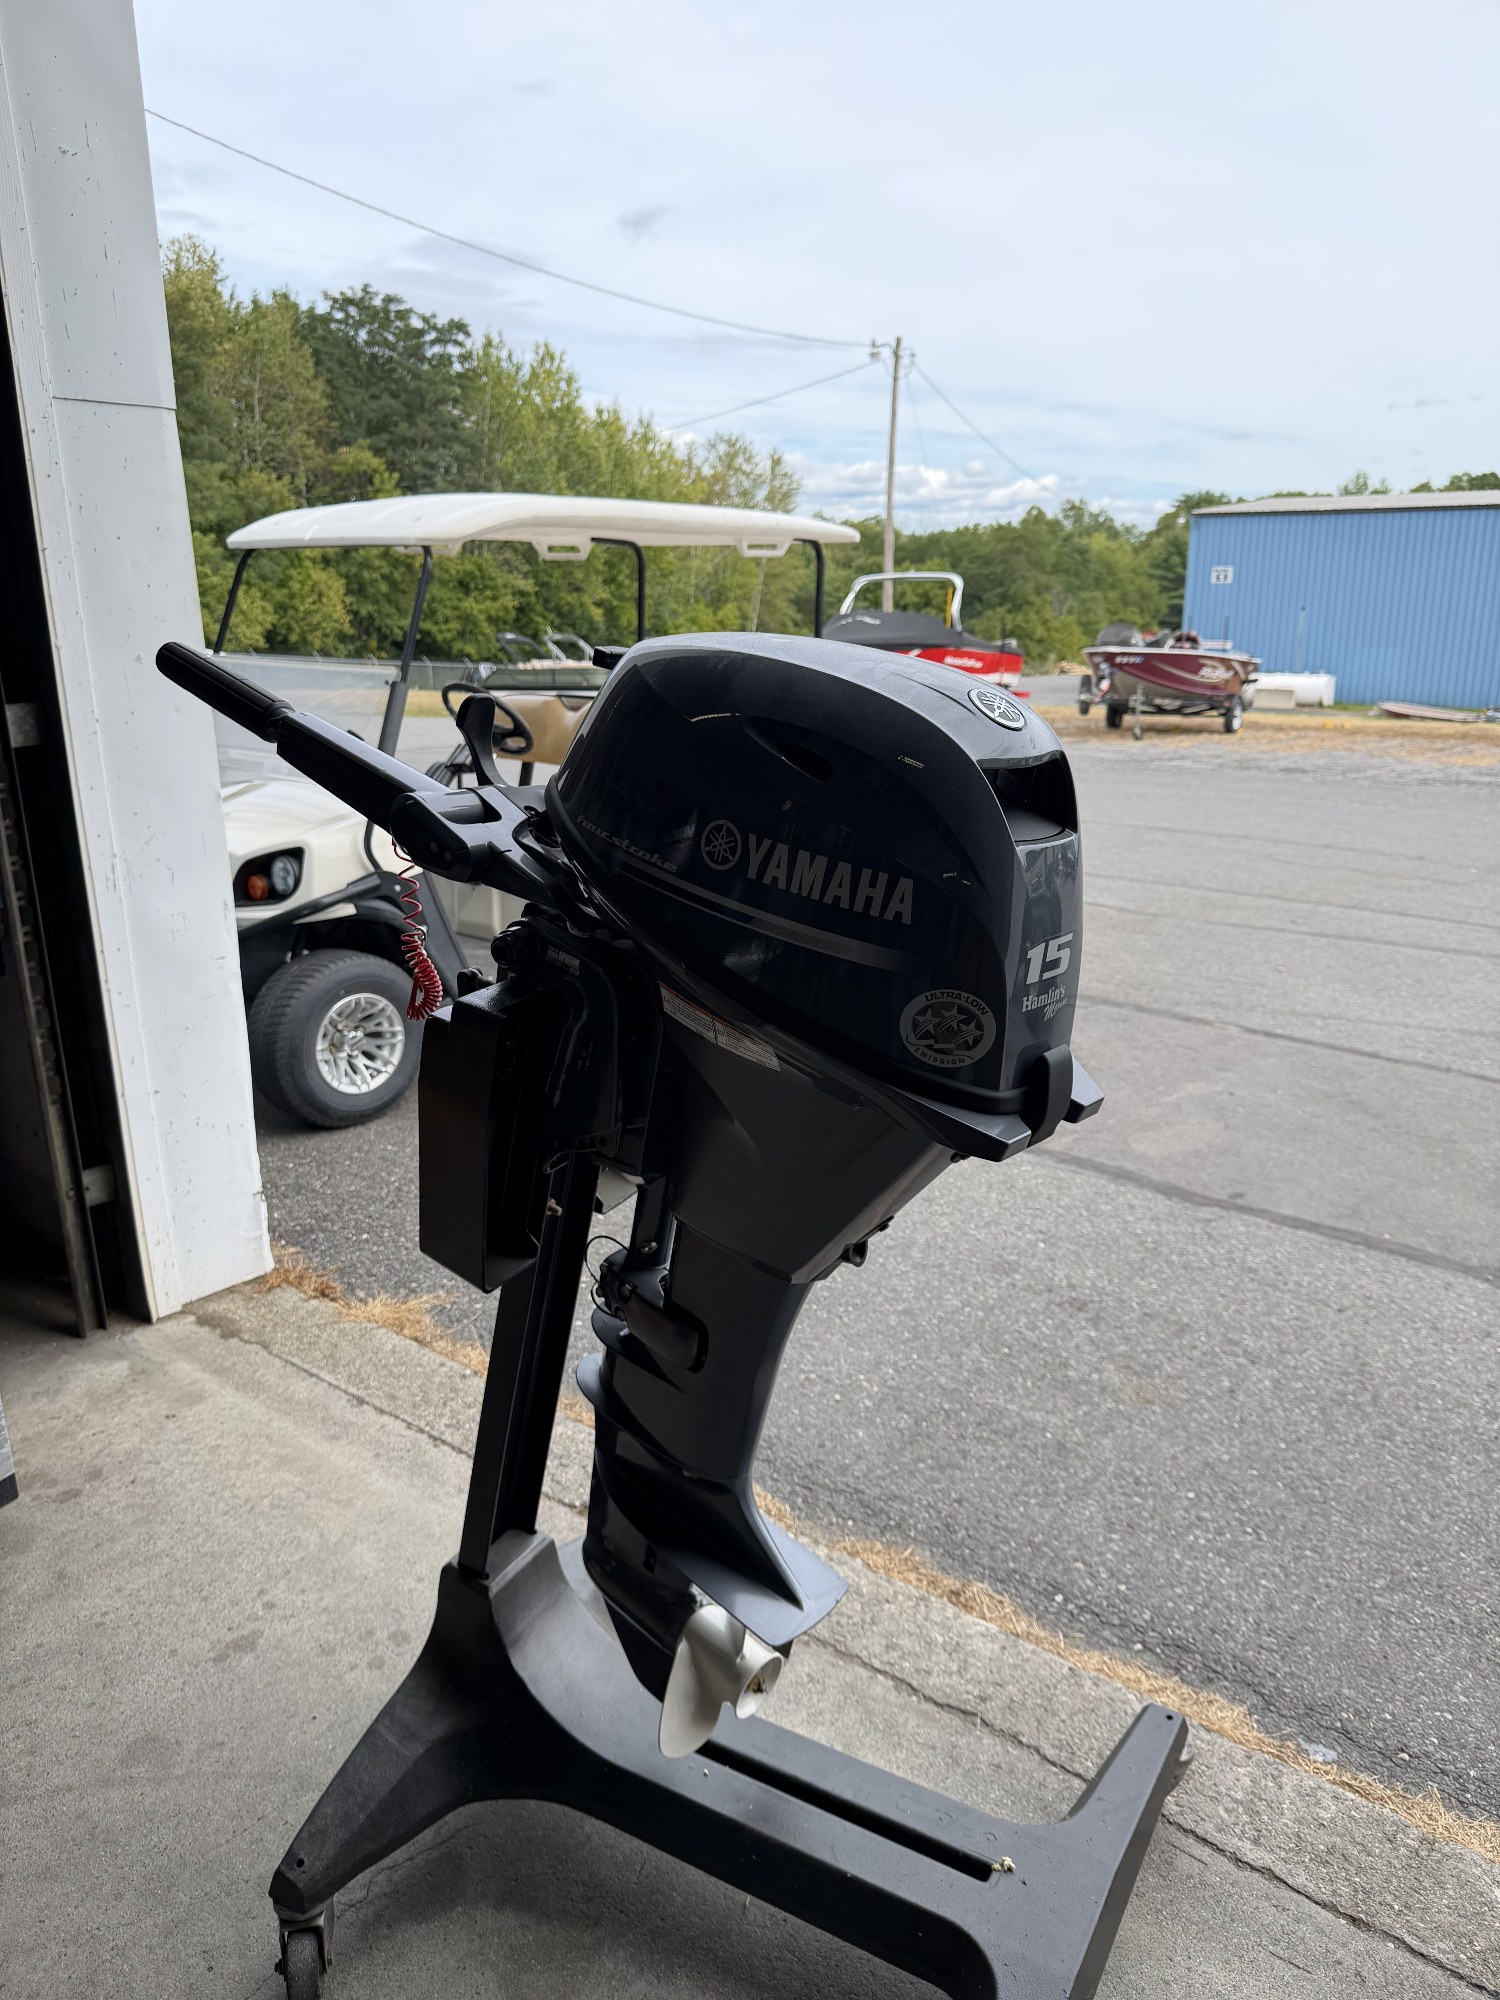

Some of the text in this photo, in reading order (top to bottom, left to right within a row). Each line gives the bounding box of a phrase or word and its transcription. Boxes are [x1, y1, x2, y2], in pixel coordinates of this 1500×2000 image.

[746, 832, 914, 925] YAMAHA
[1025, 932, 1074, 985] 15
[1021, 984, 1066, 1013] Hamlin's
[913, 1046, 965, 1065] EMISSION
